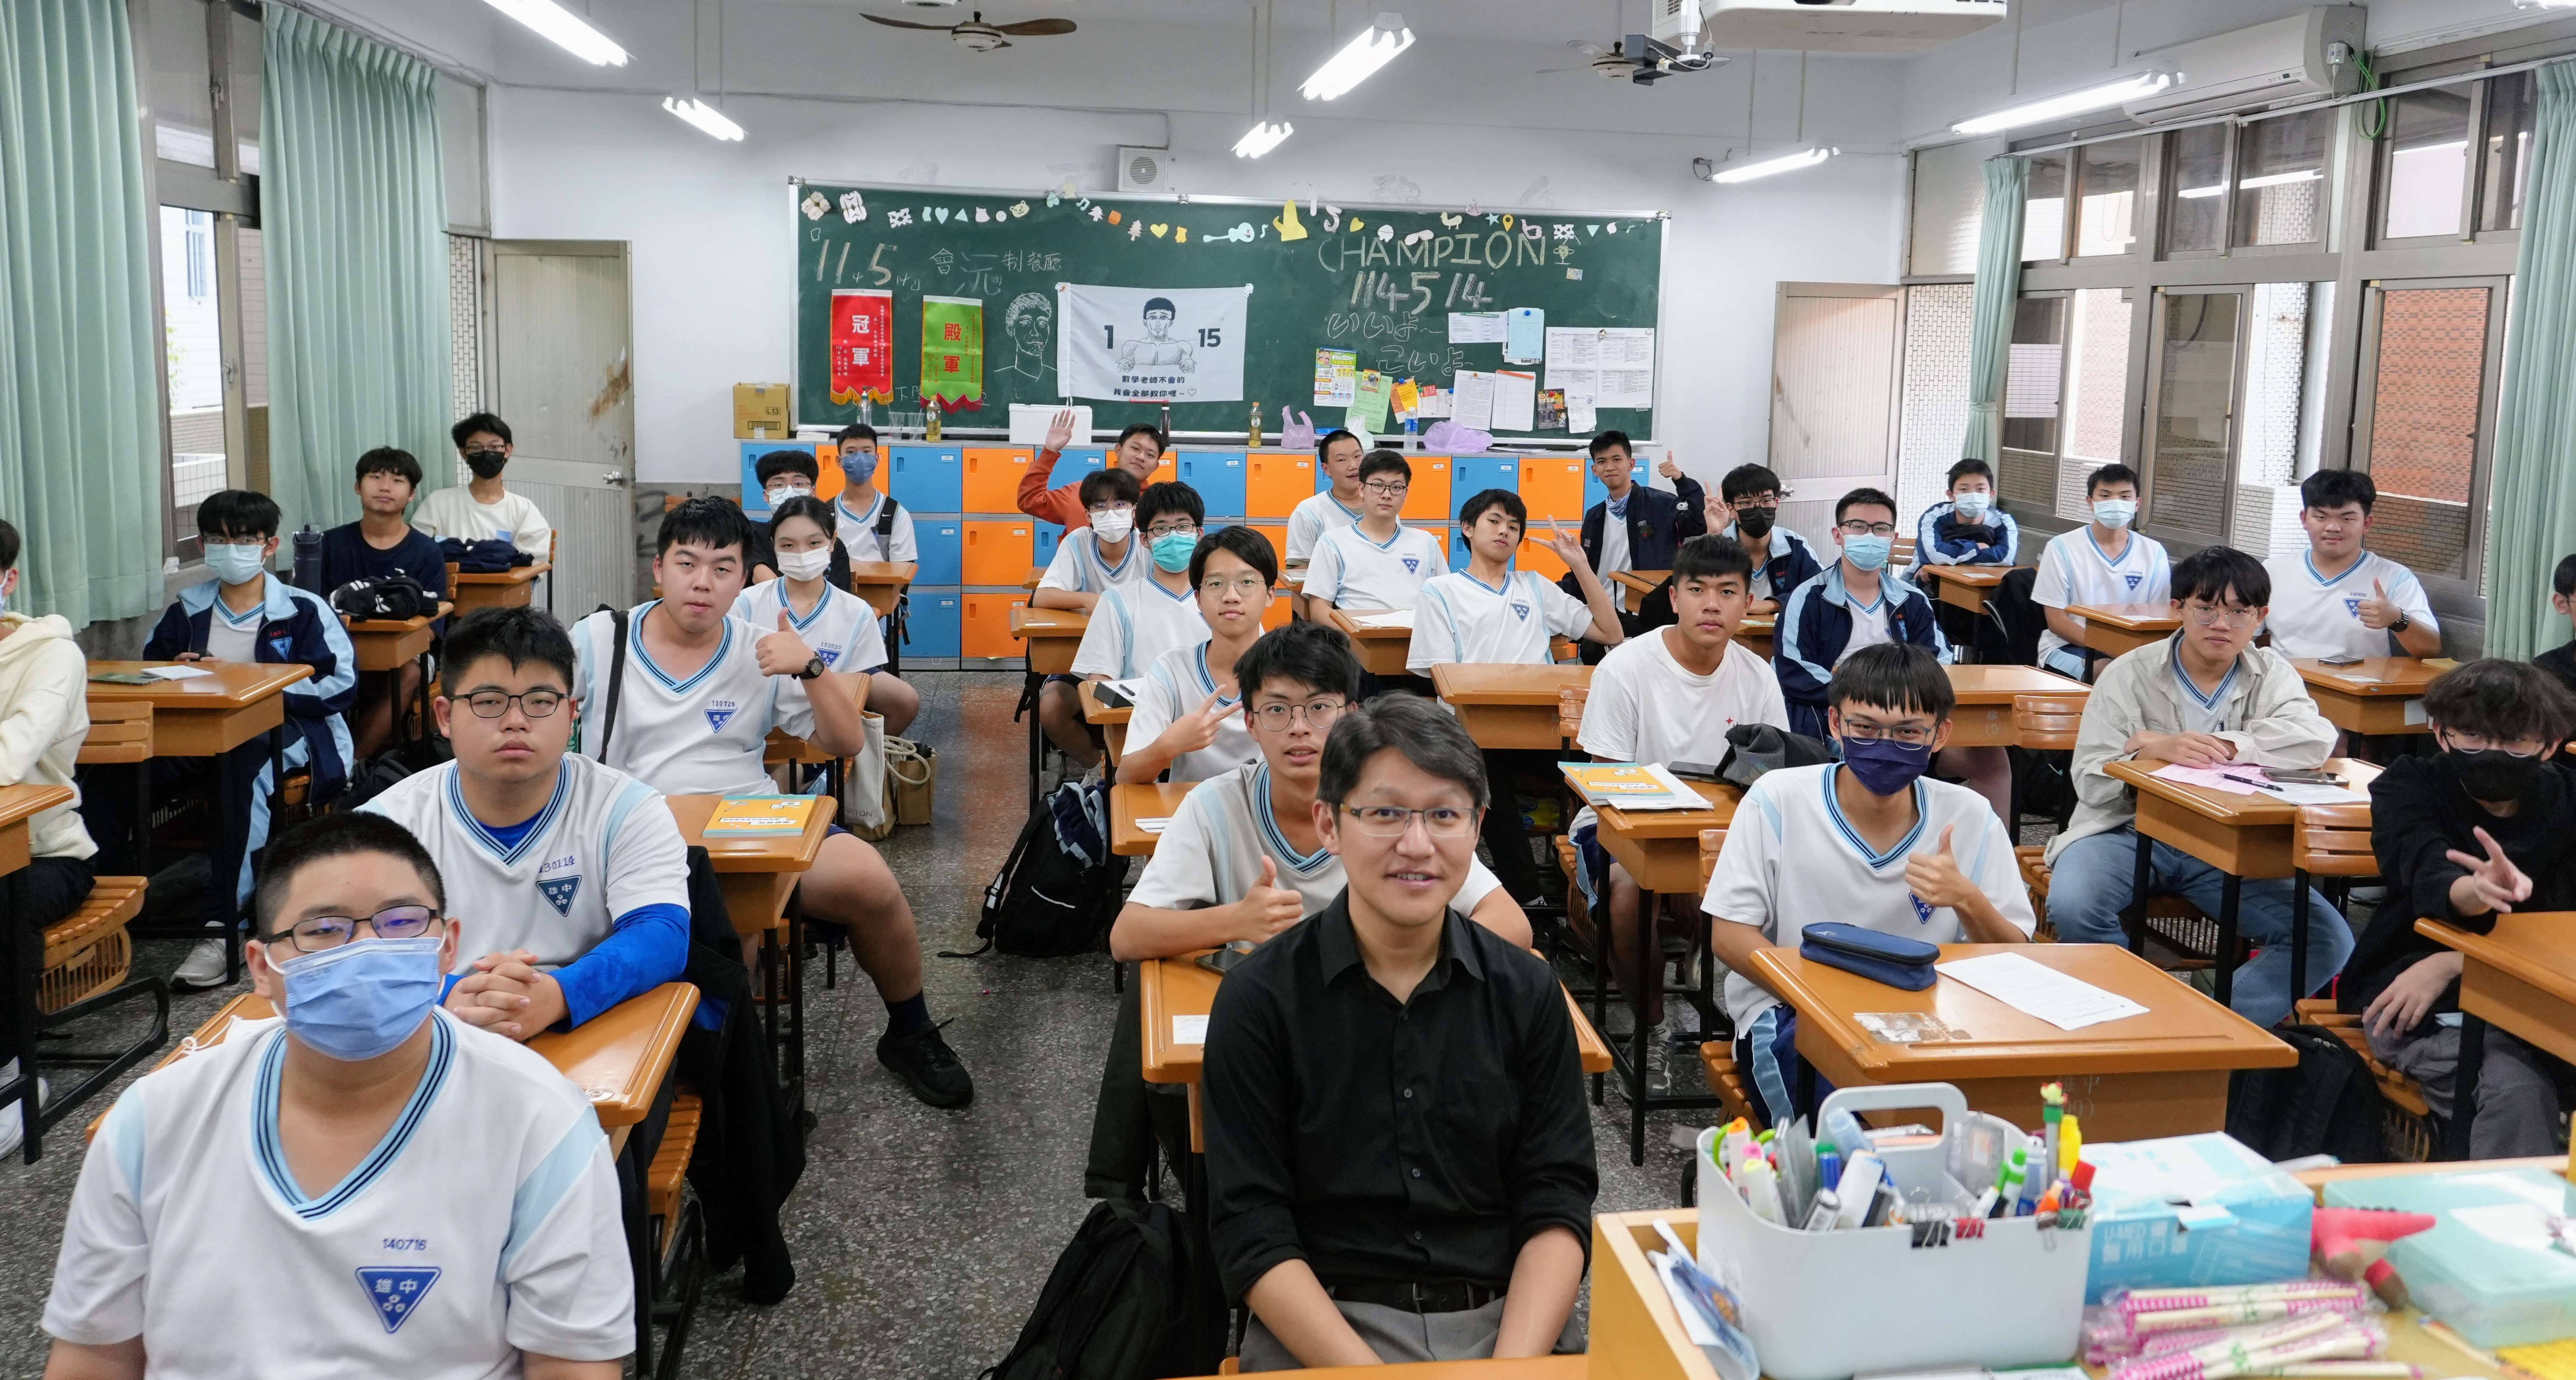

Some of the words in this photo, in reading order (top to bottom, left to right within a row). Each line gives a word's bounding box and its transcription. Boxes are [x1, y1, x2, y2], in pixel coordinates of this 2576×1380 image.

[1318, 230, 1546, 272] CHAMPION
[1351, 270, 1493, 315] 114514
[852, 315, 870, 366] 冠軍
[1104, 325, 1114, 349] 1
[1198, 328, 1221, 347] 15
[943, 323, 962, 373] 殿軍
[1122, 375, 1185, 384] 數學老師不會的
[539, 855, 575, 873] 130114
[548, 883, 572, 895] 雄中
[382, 1237, 427, 1251] 140716
[375, 1278, 418, 1294] 雄中
